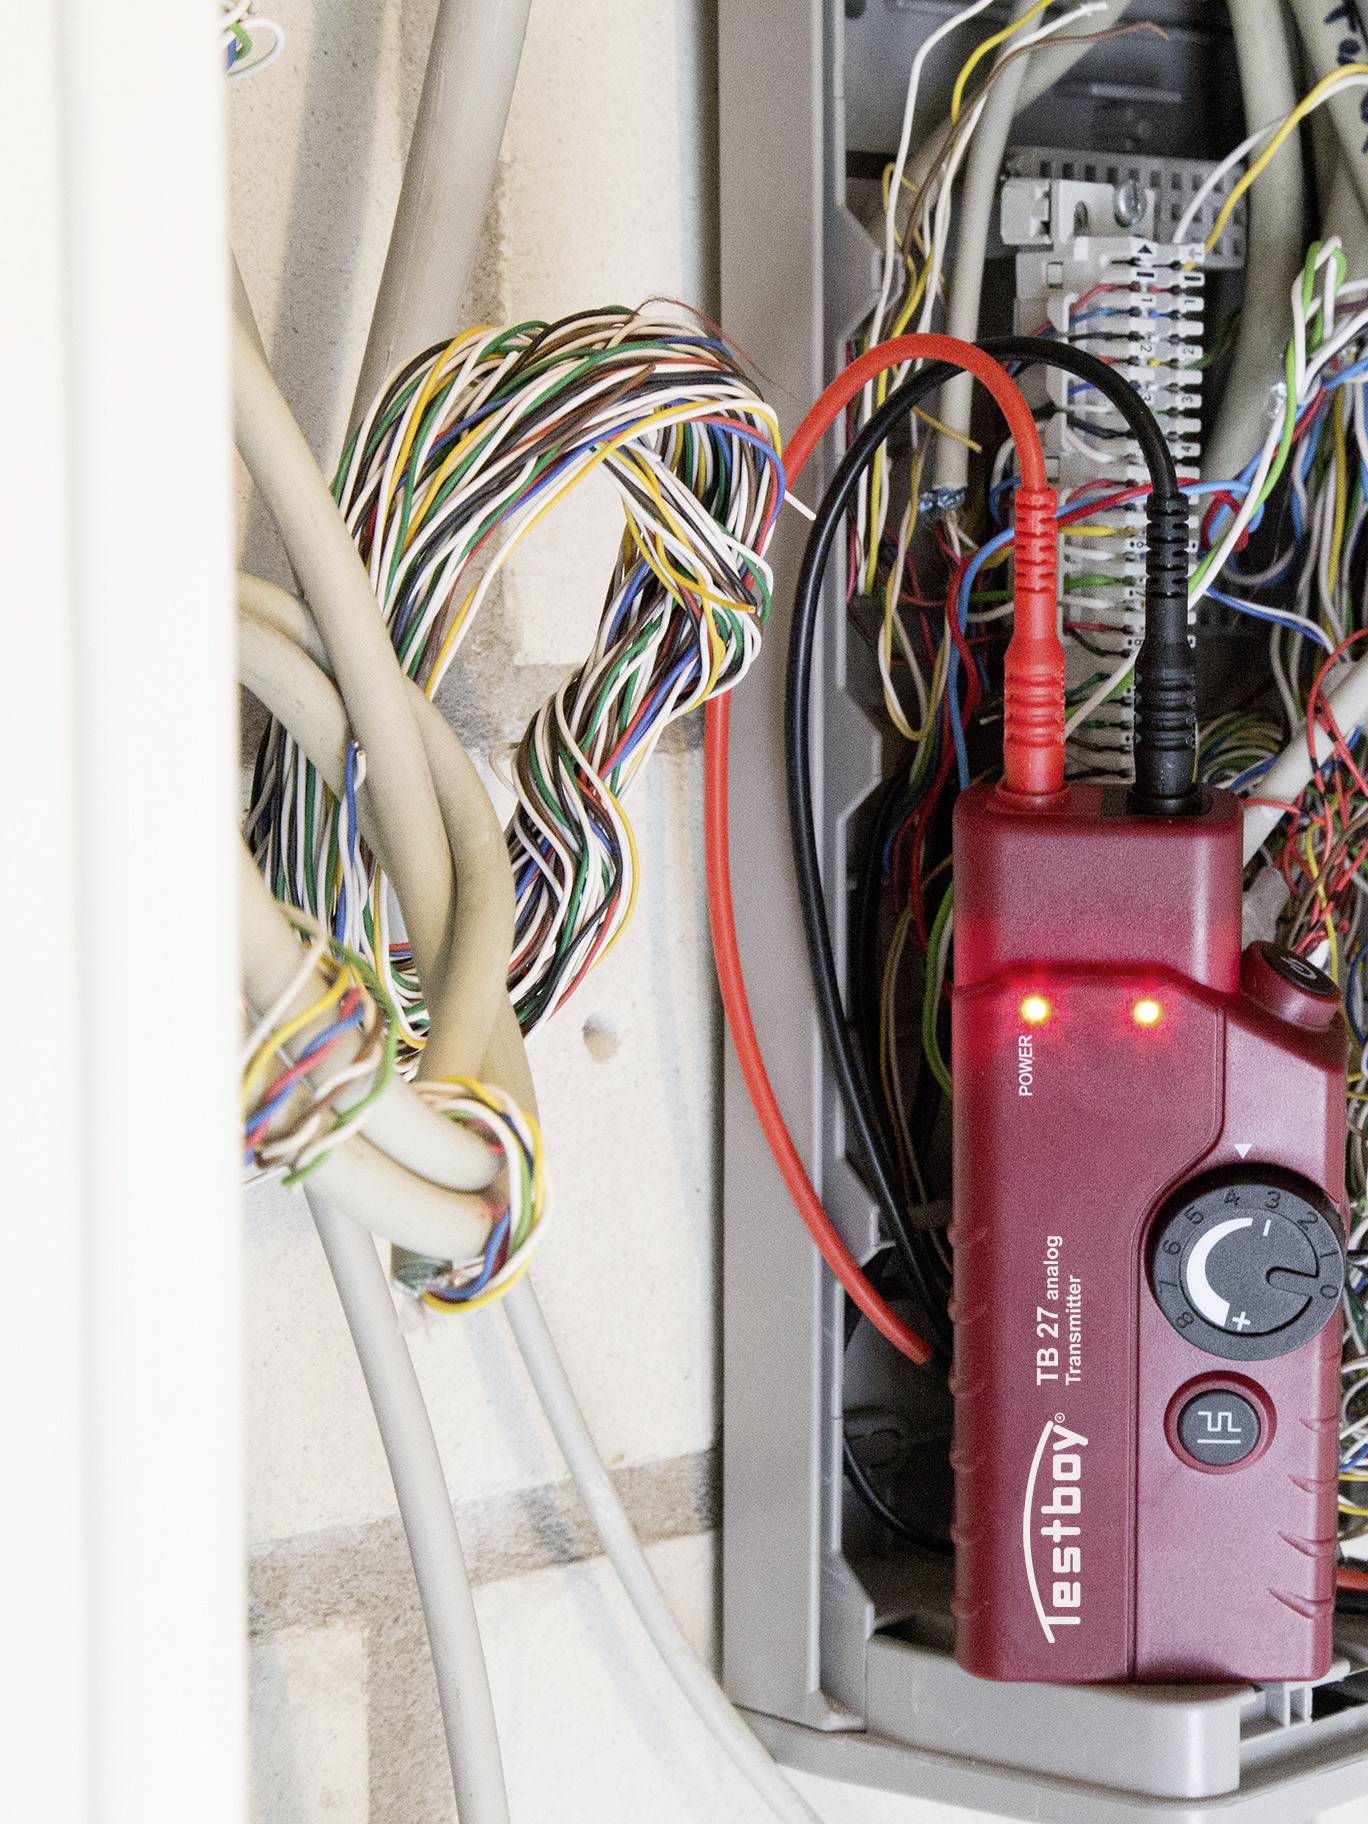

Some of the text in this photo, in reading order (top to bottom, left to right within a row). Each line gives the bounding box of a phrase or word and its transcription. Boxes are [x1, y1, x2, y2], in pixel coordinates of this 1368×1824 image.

[1018, 1035, 1034, 1097] POWER
[1224, 1189, 1241, 1206] 4
[1264, 1190, 1282, 1210] 3
[1184, 1205, 1205, 1225] 5
[1296, 1211, 1319, 1232] 2
[1163, 1239, 1182, 1255] 6
[1319, 1249, 1339, 1258] 1
[1036, 1235, 1063, 1386] TB 27 analog
[1176, 1311, 1195, 1330] 8
[1065, 1275, 1082, 1386] Transmitter
